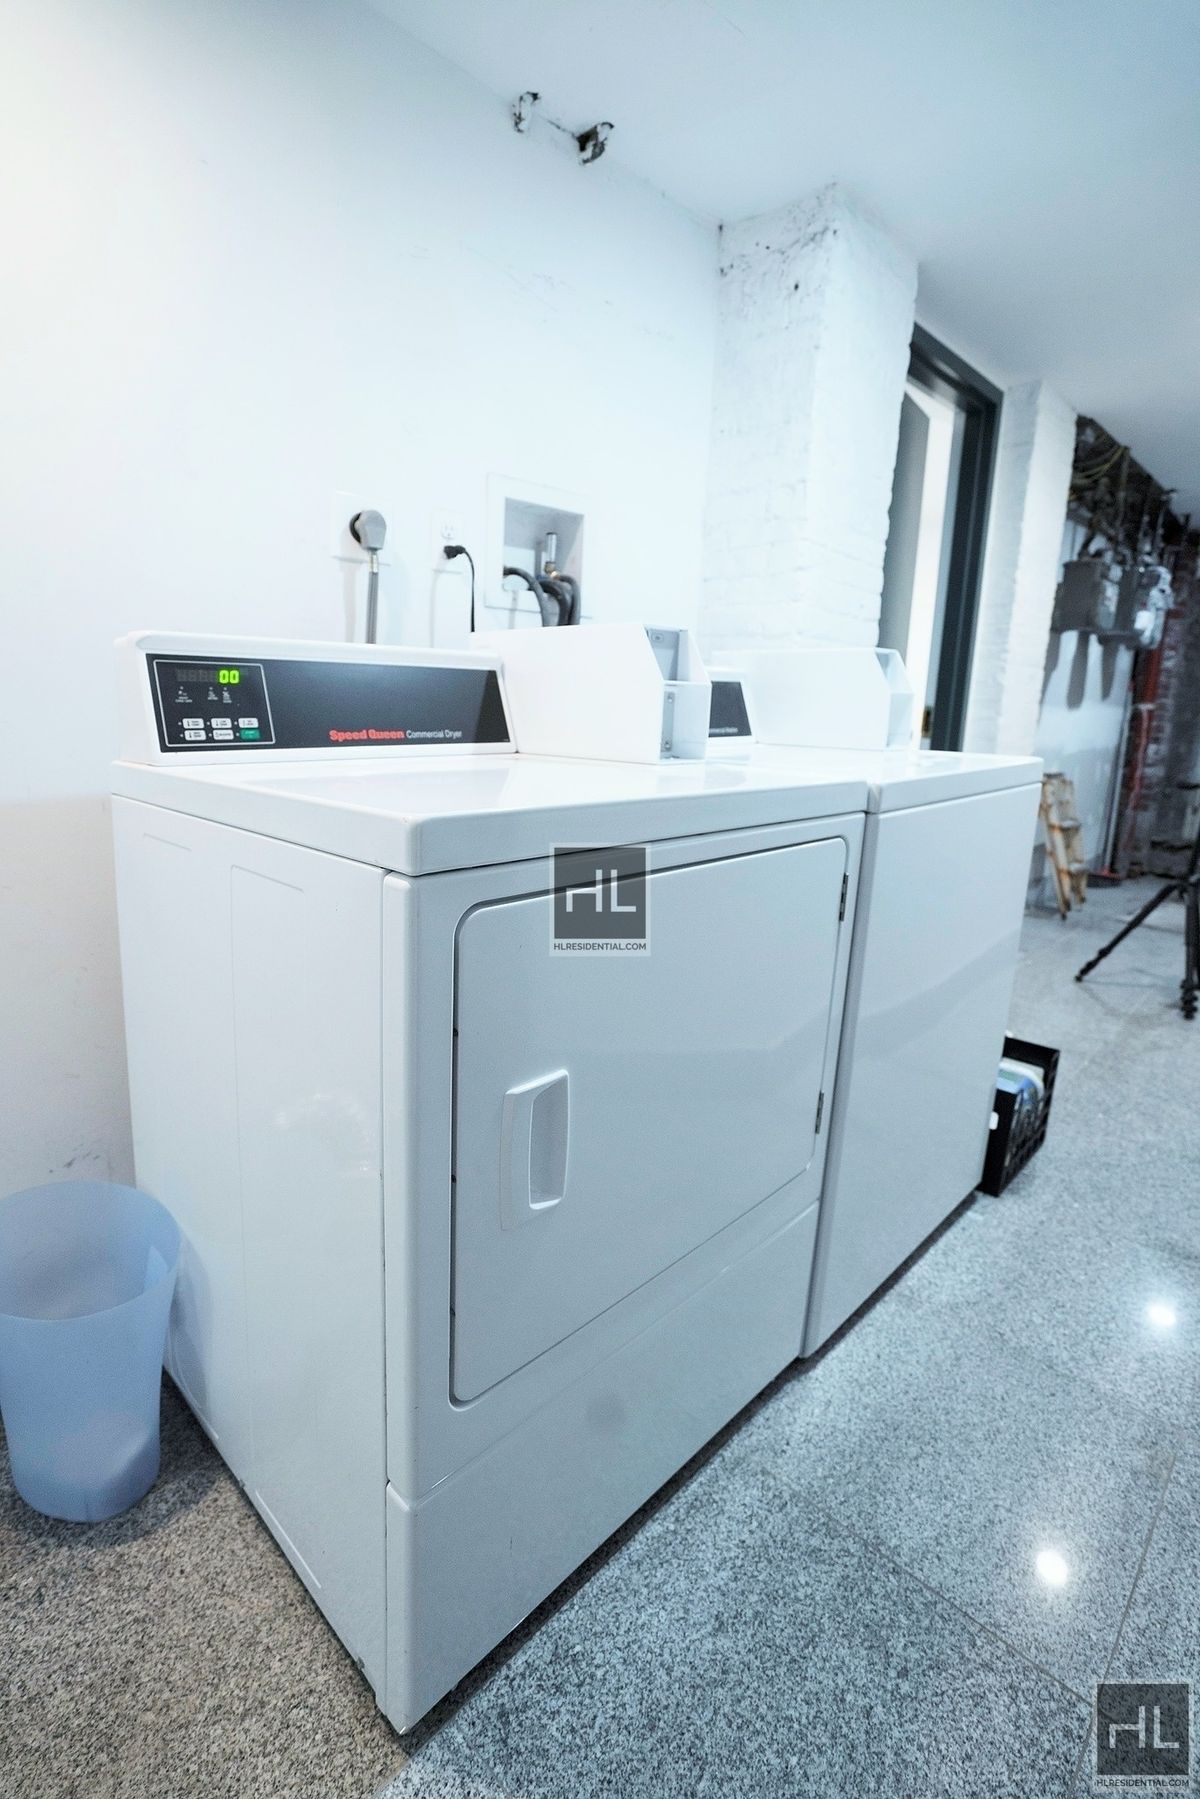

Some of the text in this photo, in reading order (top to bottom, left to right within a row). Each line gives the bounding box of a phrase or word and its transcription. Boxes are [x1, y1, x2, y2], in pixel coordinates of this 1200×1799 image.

[219, 669, 240, 684] 00
[329, 729, 462, 741] Speed Queen Commercial Dryer
